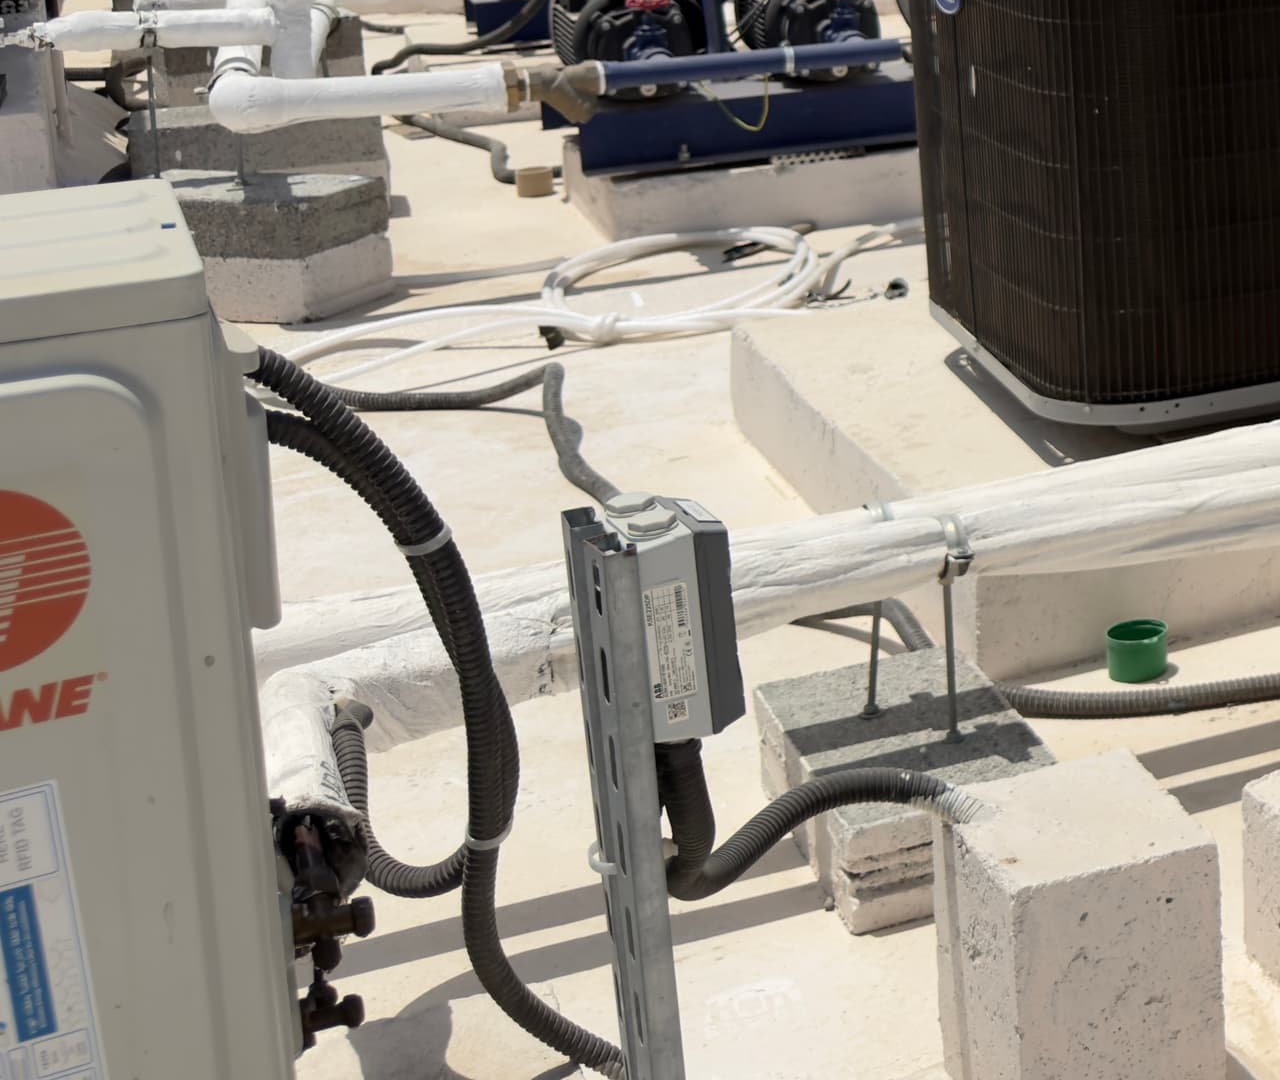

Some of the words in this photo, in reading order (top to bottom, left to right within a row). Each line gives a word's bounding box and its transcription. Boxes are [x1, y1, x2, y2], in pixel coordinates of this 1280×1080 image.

[653, 683, 664, 698] ABB
[9, 807, 25, 836] TAG
[15, 839, 32, 872] RFID
